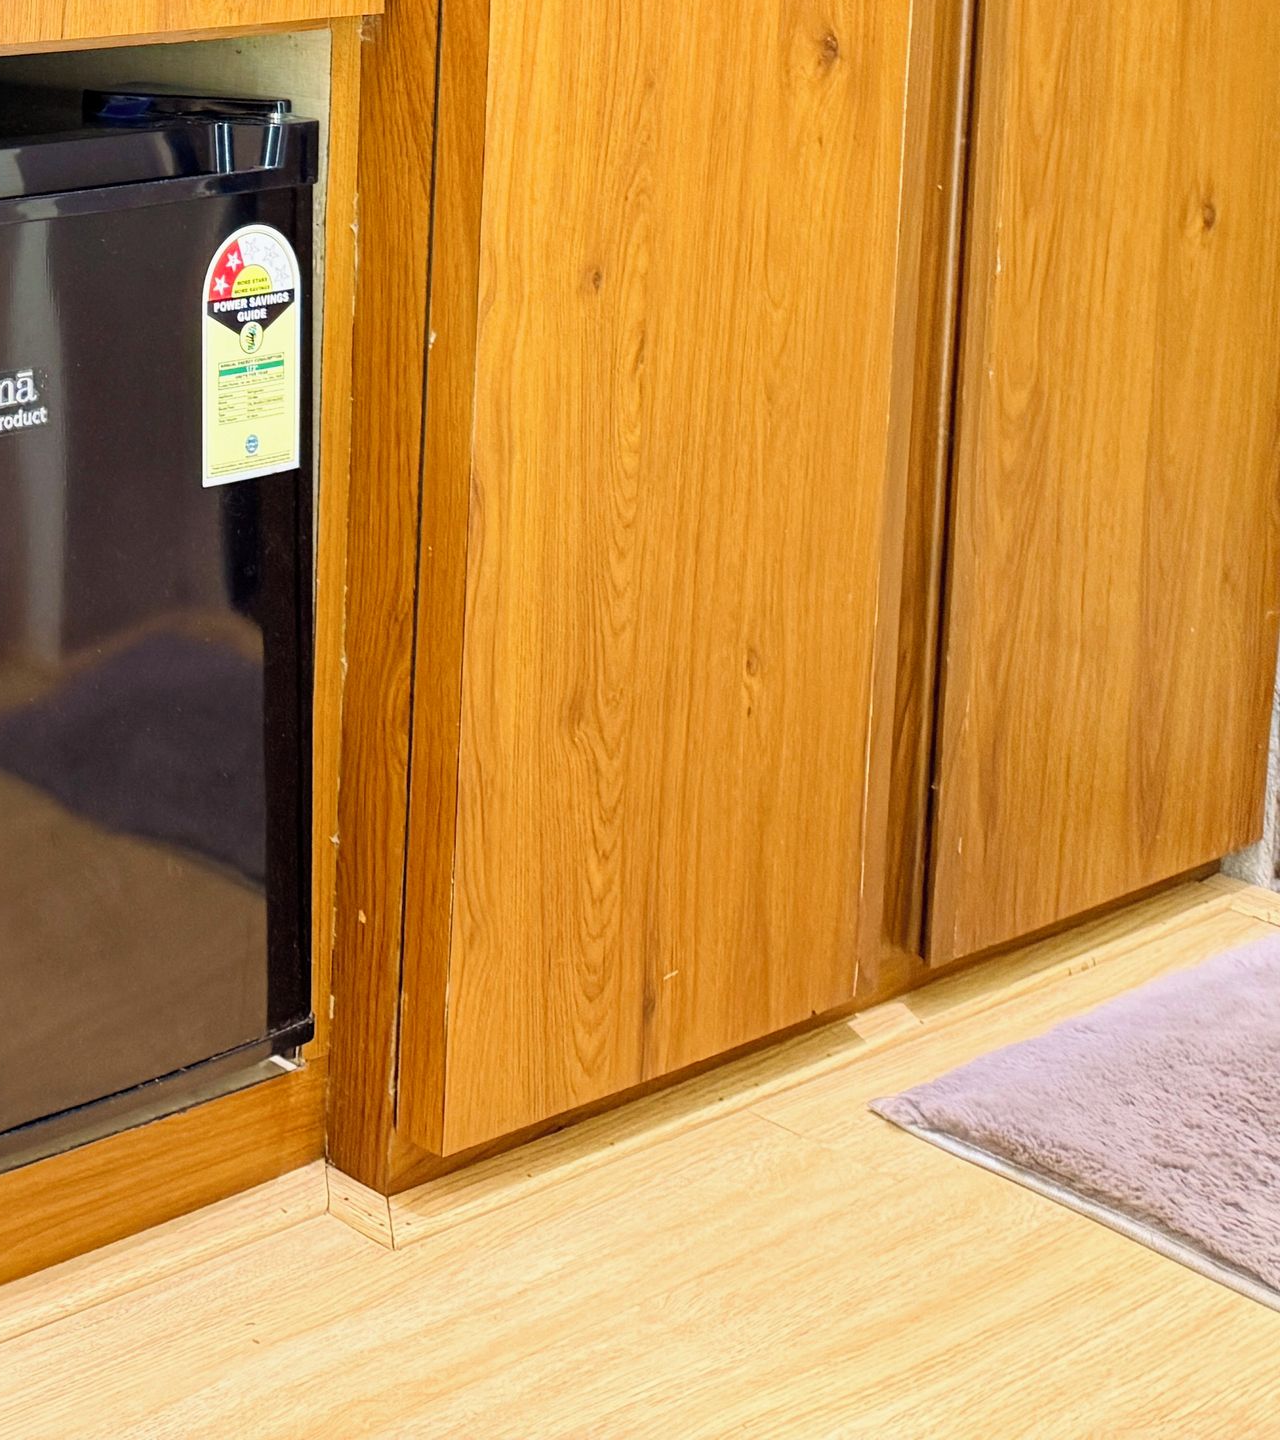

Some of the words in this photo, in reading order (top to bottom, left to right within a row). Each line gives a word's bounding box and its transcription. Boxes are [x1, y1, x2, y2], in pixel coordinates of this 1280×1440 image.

[213, 298, 248, 313] POWER
[249, 291, 290, 307] SAVINGS
[237, 308, 268, 322] GUIDE
